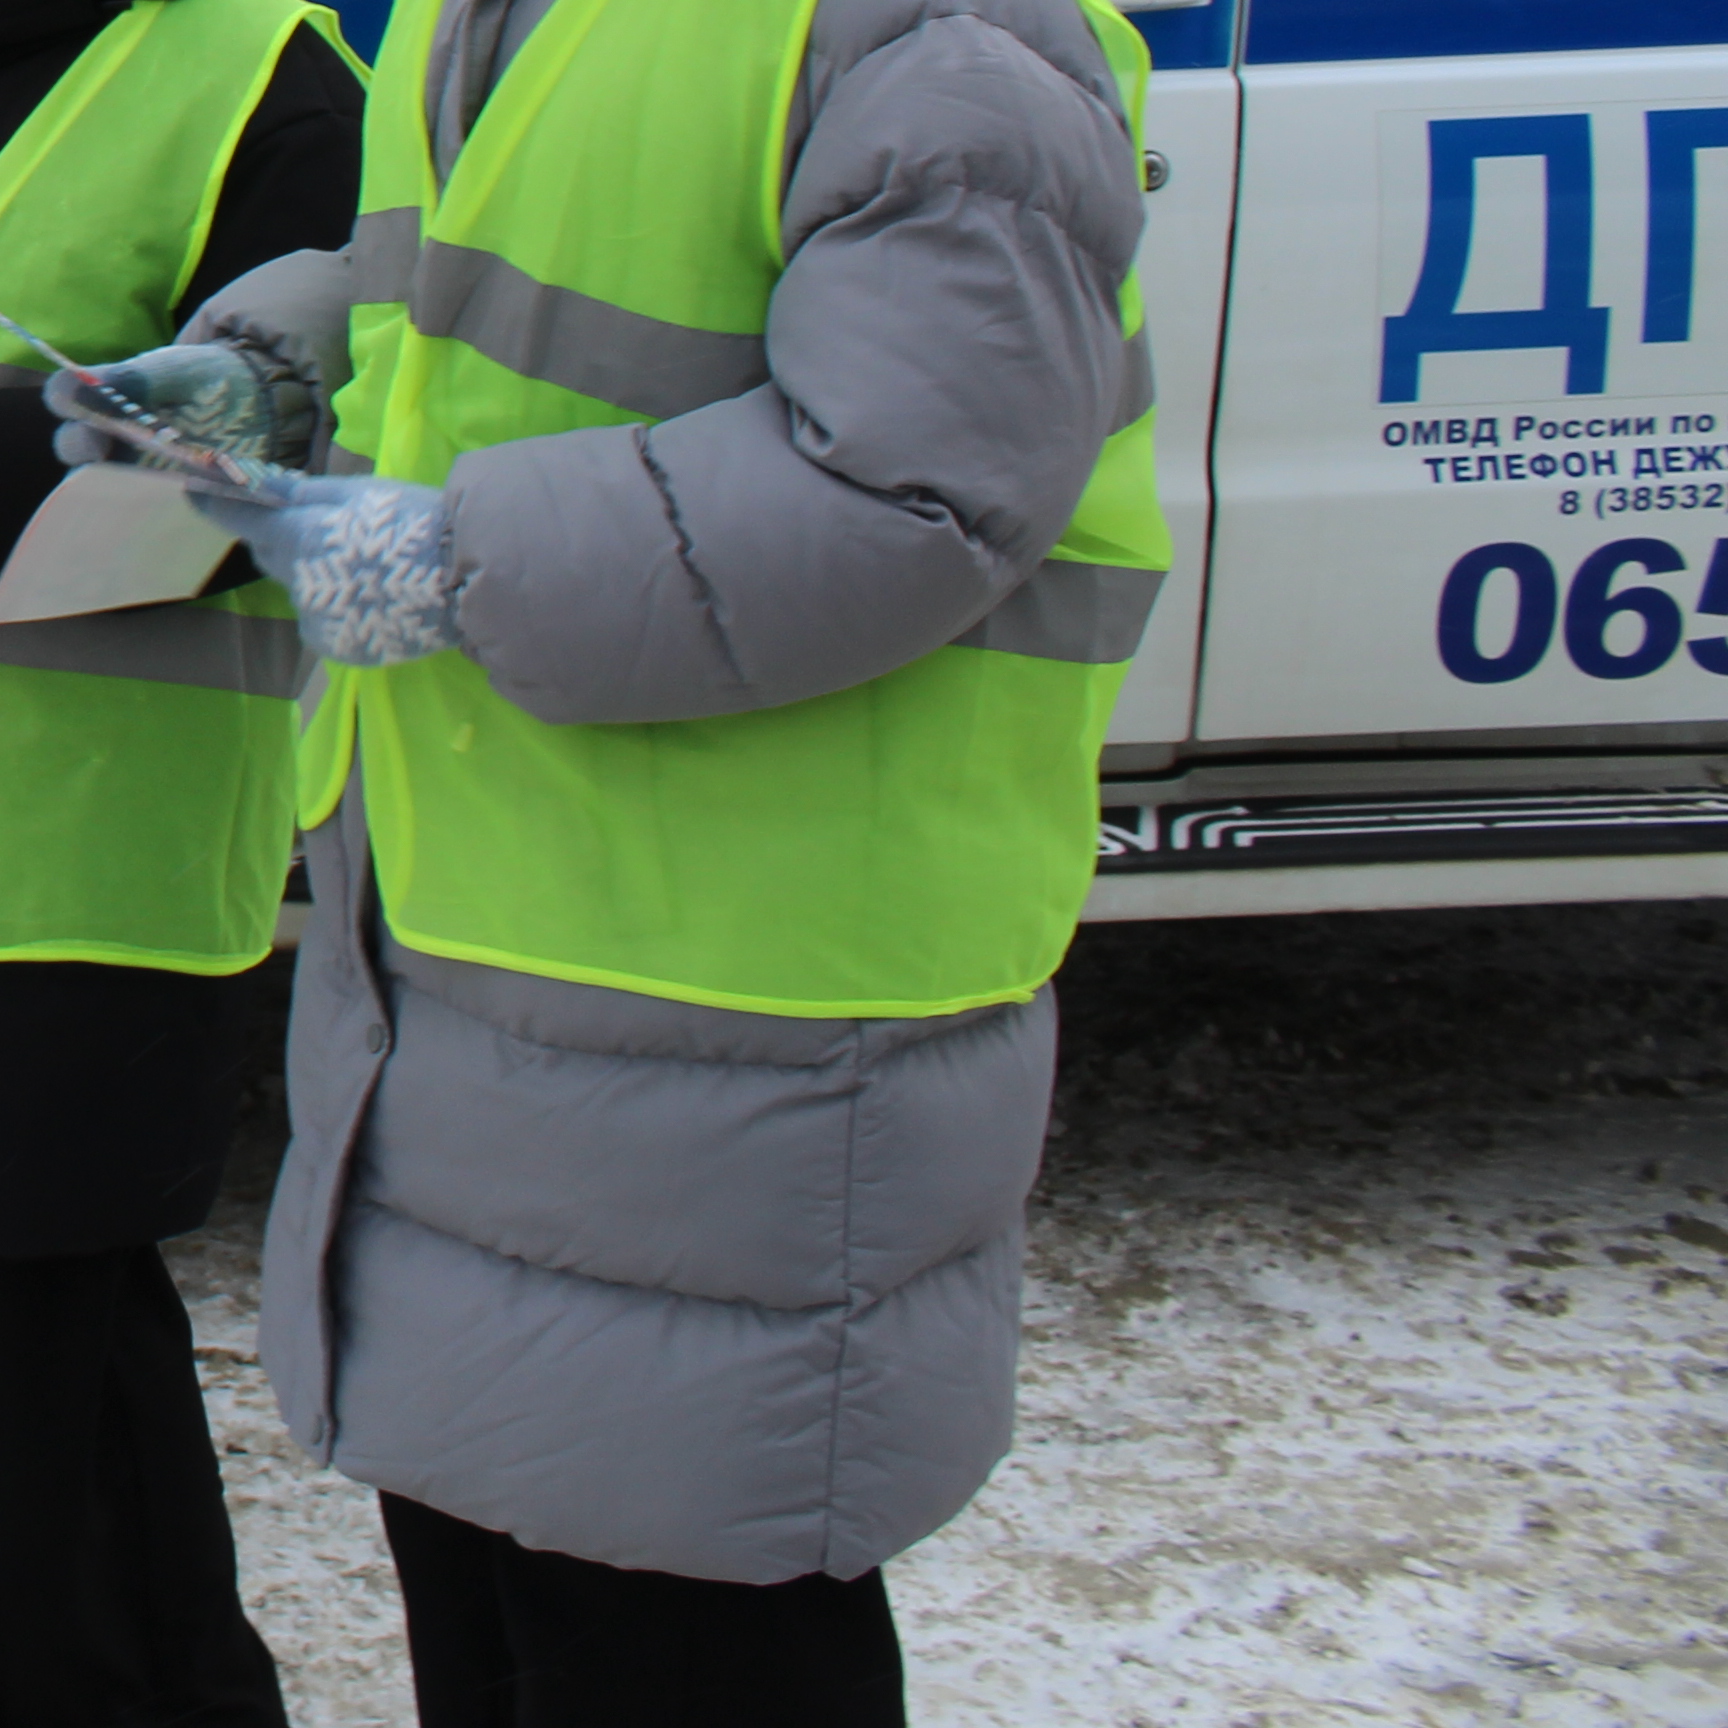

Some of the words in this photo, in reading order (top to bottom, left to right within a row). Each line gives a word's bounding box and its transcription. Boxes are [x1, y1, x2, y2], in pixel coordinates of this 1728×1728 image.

[1382, 416, 1500, 449] ОМВД
[1513, 415, 1657, 441] России
[1670, 414, 1716, 435] по
[1423, 449, 1618, 484] ТЕЛЕФОН
[1632, 443, 1728, 480] ДЕЖ
[1559, 490, 1580, 515] 8
